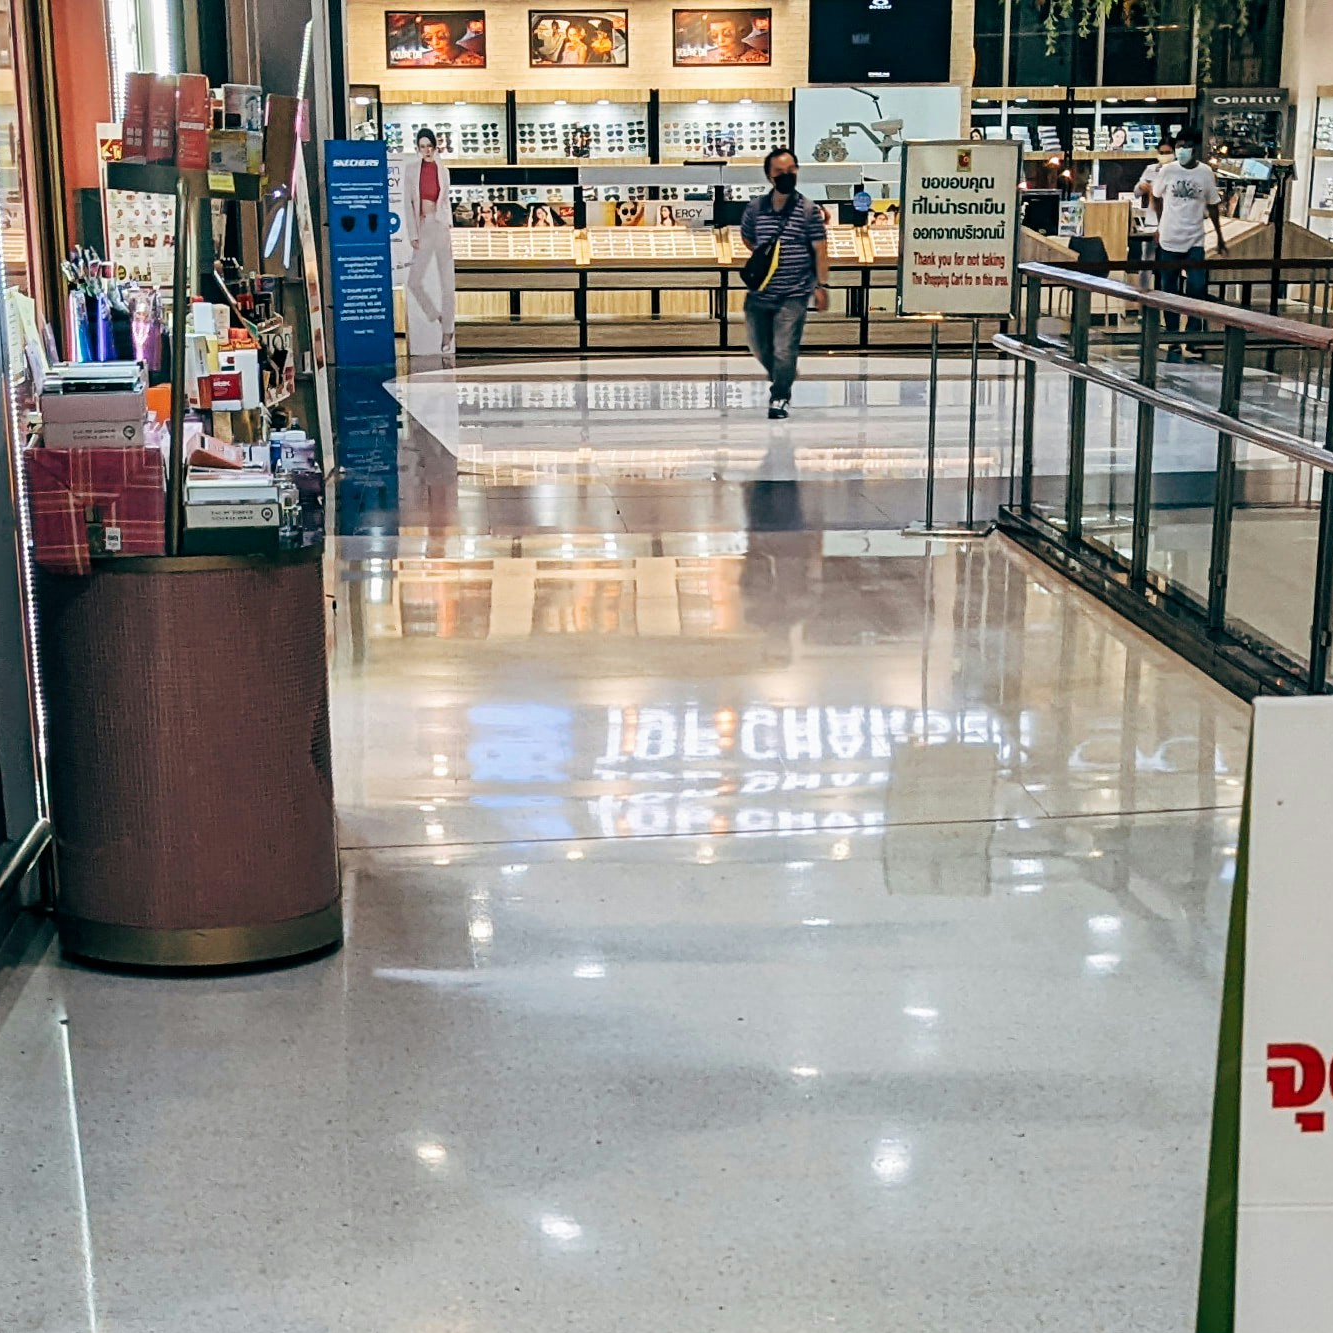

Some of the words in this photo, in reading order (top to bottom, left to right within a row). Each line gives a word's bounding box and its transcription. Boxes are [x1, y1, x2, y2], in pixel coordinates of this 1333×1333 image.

[1231, 96, 1281, 104] OAKLEY
[332, 159, 380, 168] SKECHERS
[921, 176, 995, 193] ขอขอบคุณ
[912, 195, 1006, 215] ที่ไม่นำรถเข็น
[912, 220, 1006, 240] ออกจากบริเวณนี้
[913, 252, 935, 266] Thank
[938, 255, 952, 269] you
[954, 252, 965, 266] for
[967, 252, 980, 266] not
[982, 252, 1005, 269] taking
[912, 272, 922, 285] The
[924, 272, 949, 288] Shopping
[951, 272, 964, 286] Cart
[982, 273, 993, 286] this
